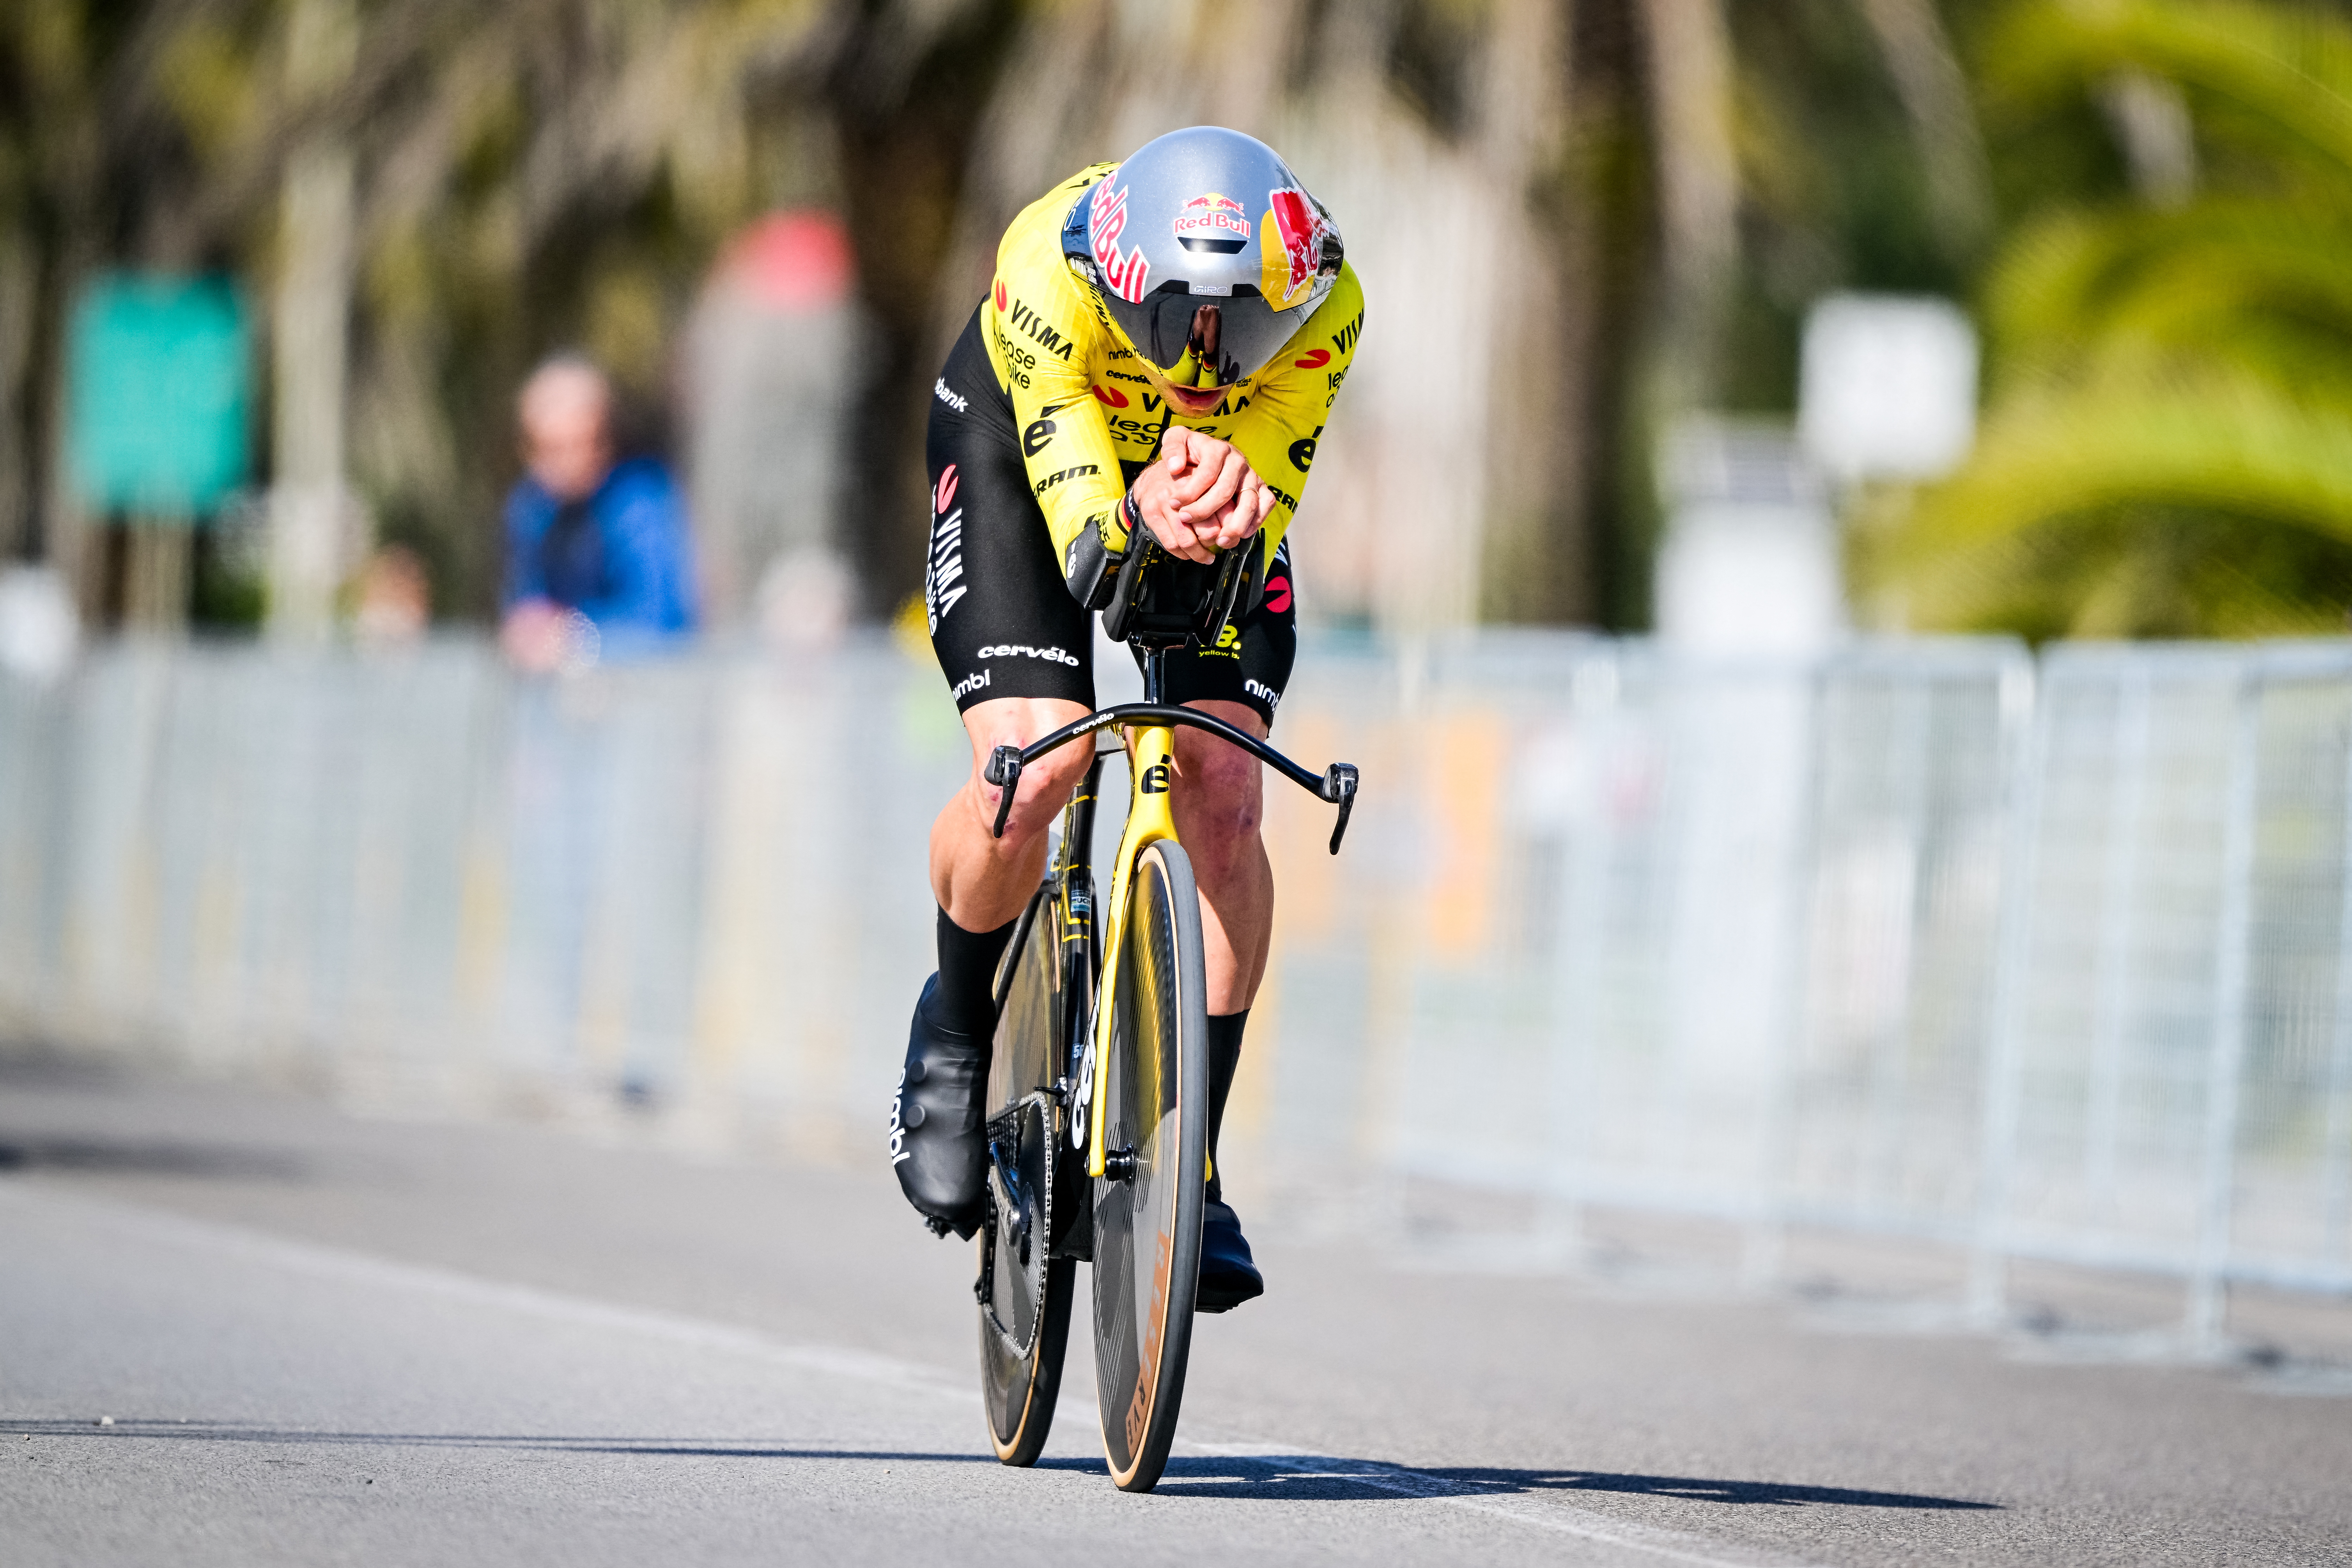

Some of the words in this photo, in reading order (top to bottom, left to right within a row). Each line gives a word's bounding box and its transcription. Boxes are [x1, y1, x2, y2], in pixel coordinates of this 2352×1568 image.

[1092, 173, 1127, 237] ed
[1175, 213, 1211, 233] Red
[1216, 214, 1249, 237] Bull
[1094, 206, 1148, 304] Bull
[1194, 285, 1228, 294] GIRO
[1011, 298, 1074, 361] VISMA
[999, 324, 1036, 370] lease
[1108, 348, 1133, 360] nimb
[936, 508, 967, 618] VISMA
[978, 645, 1079, 666] cervélo
[952, 669, 991, 701] nimbl
[1245, 679, 1280, 712] nimb
[1073, 713, 1115, 734] cervélo
